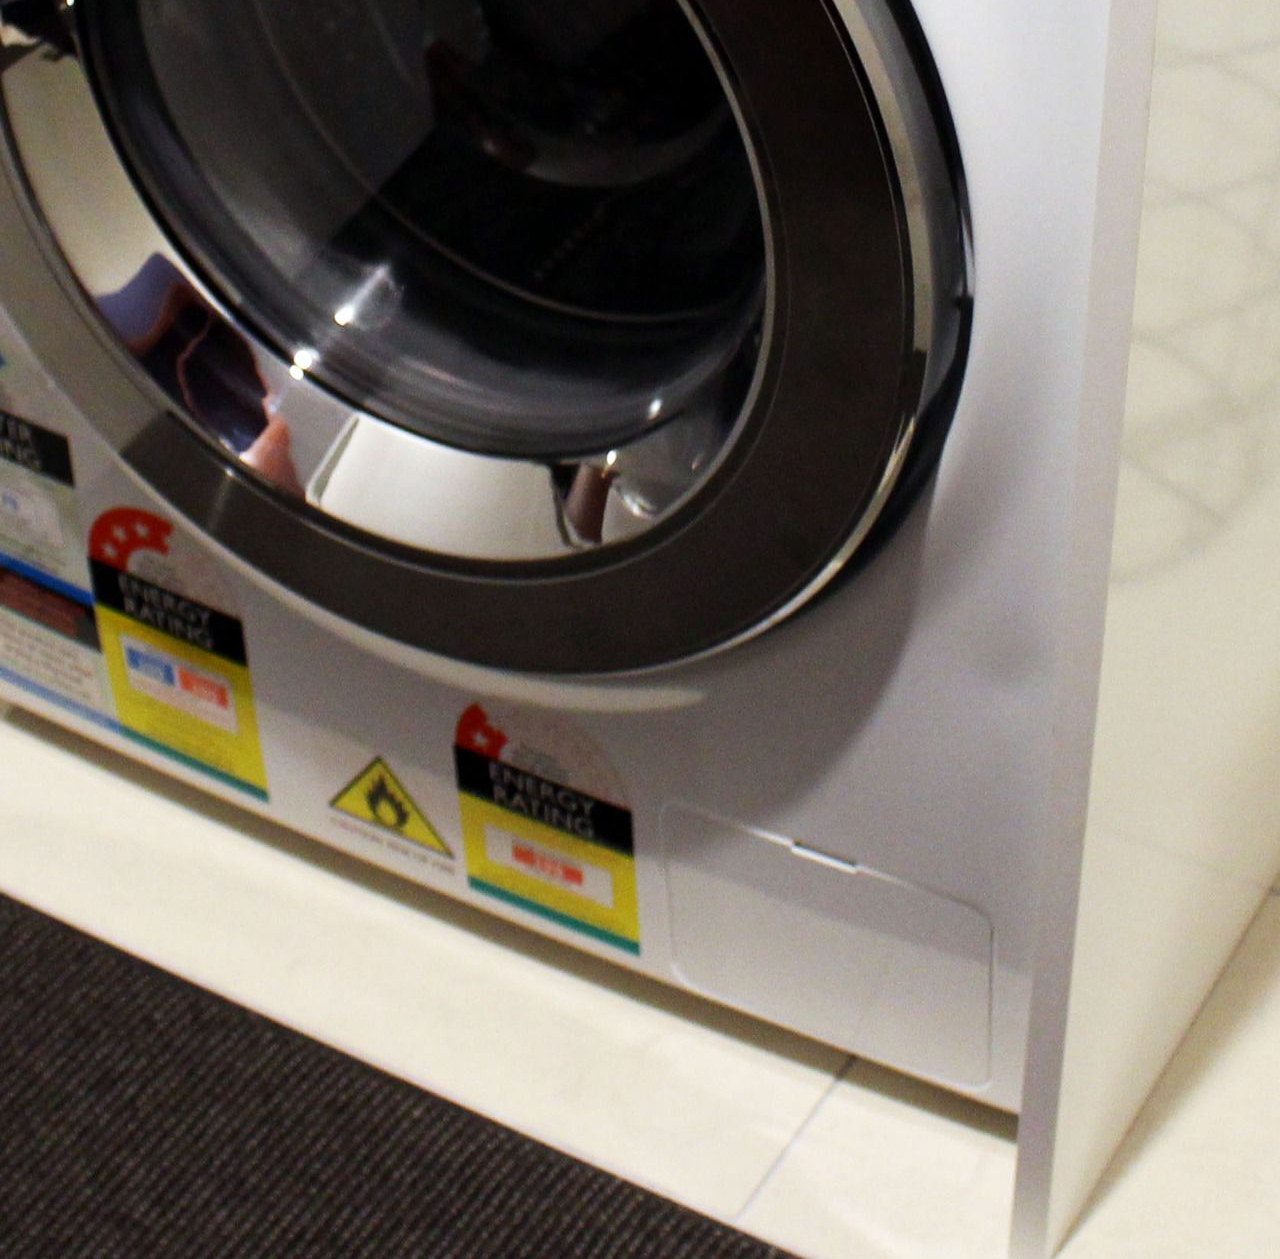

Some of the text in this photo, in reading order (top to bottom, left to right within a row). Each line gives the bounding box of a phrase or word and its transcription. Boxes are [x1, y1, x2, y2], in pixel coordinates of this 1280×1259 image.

[118, 573, 211, 627] ENERGY
[124, 597, 214, 648] RATING
[488, 762, 595, 814] ENERGY
[494, 785, 595, 837] RATING
